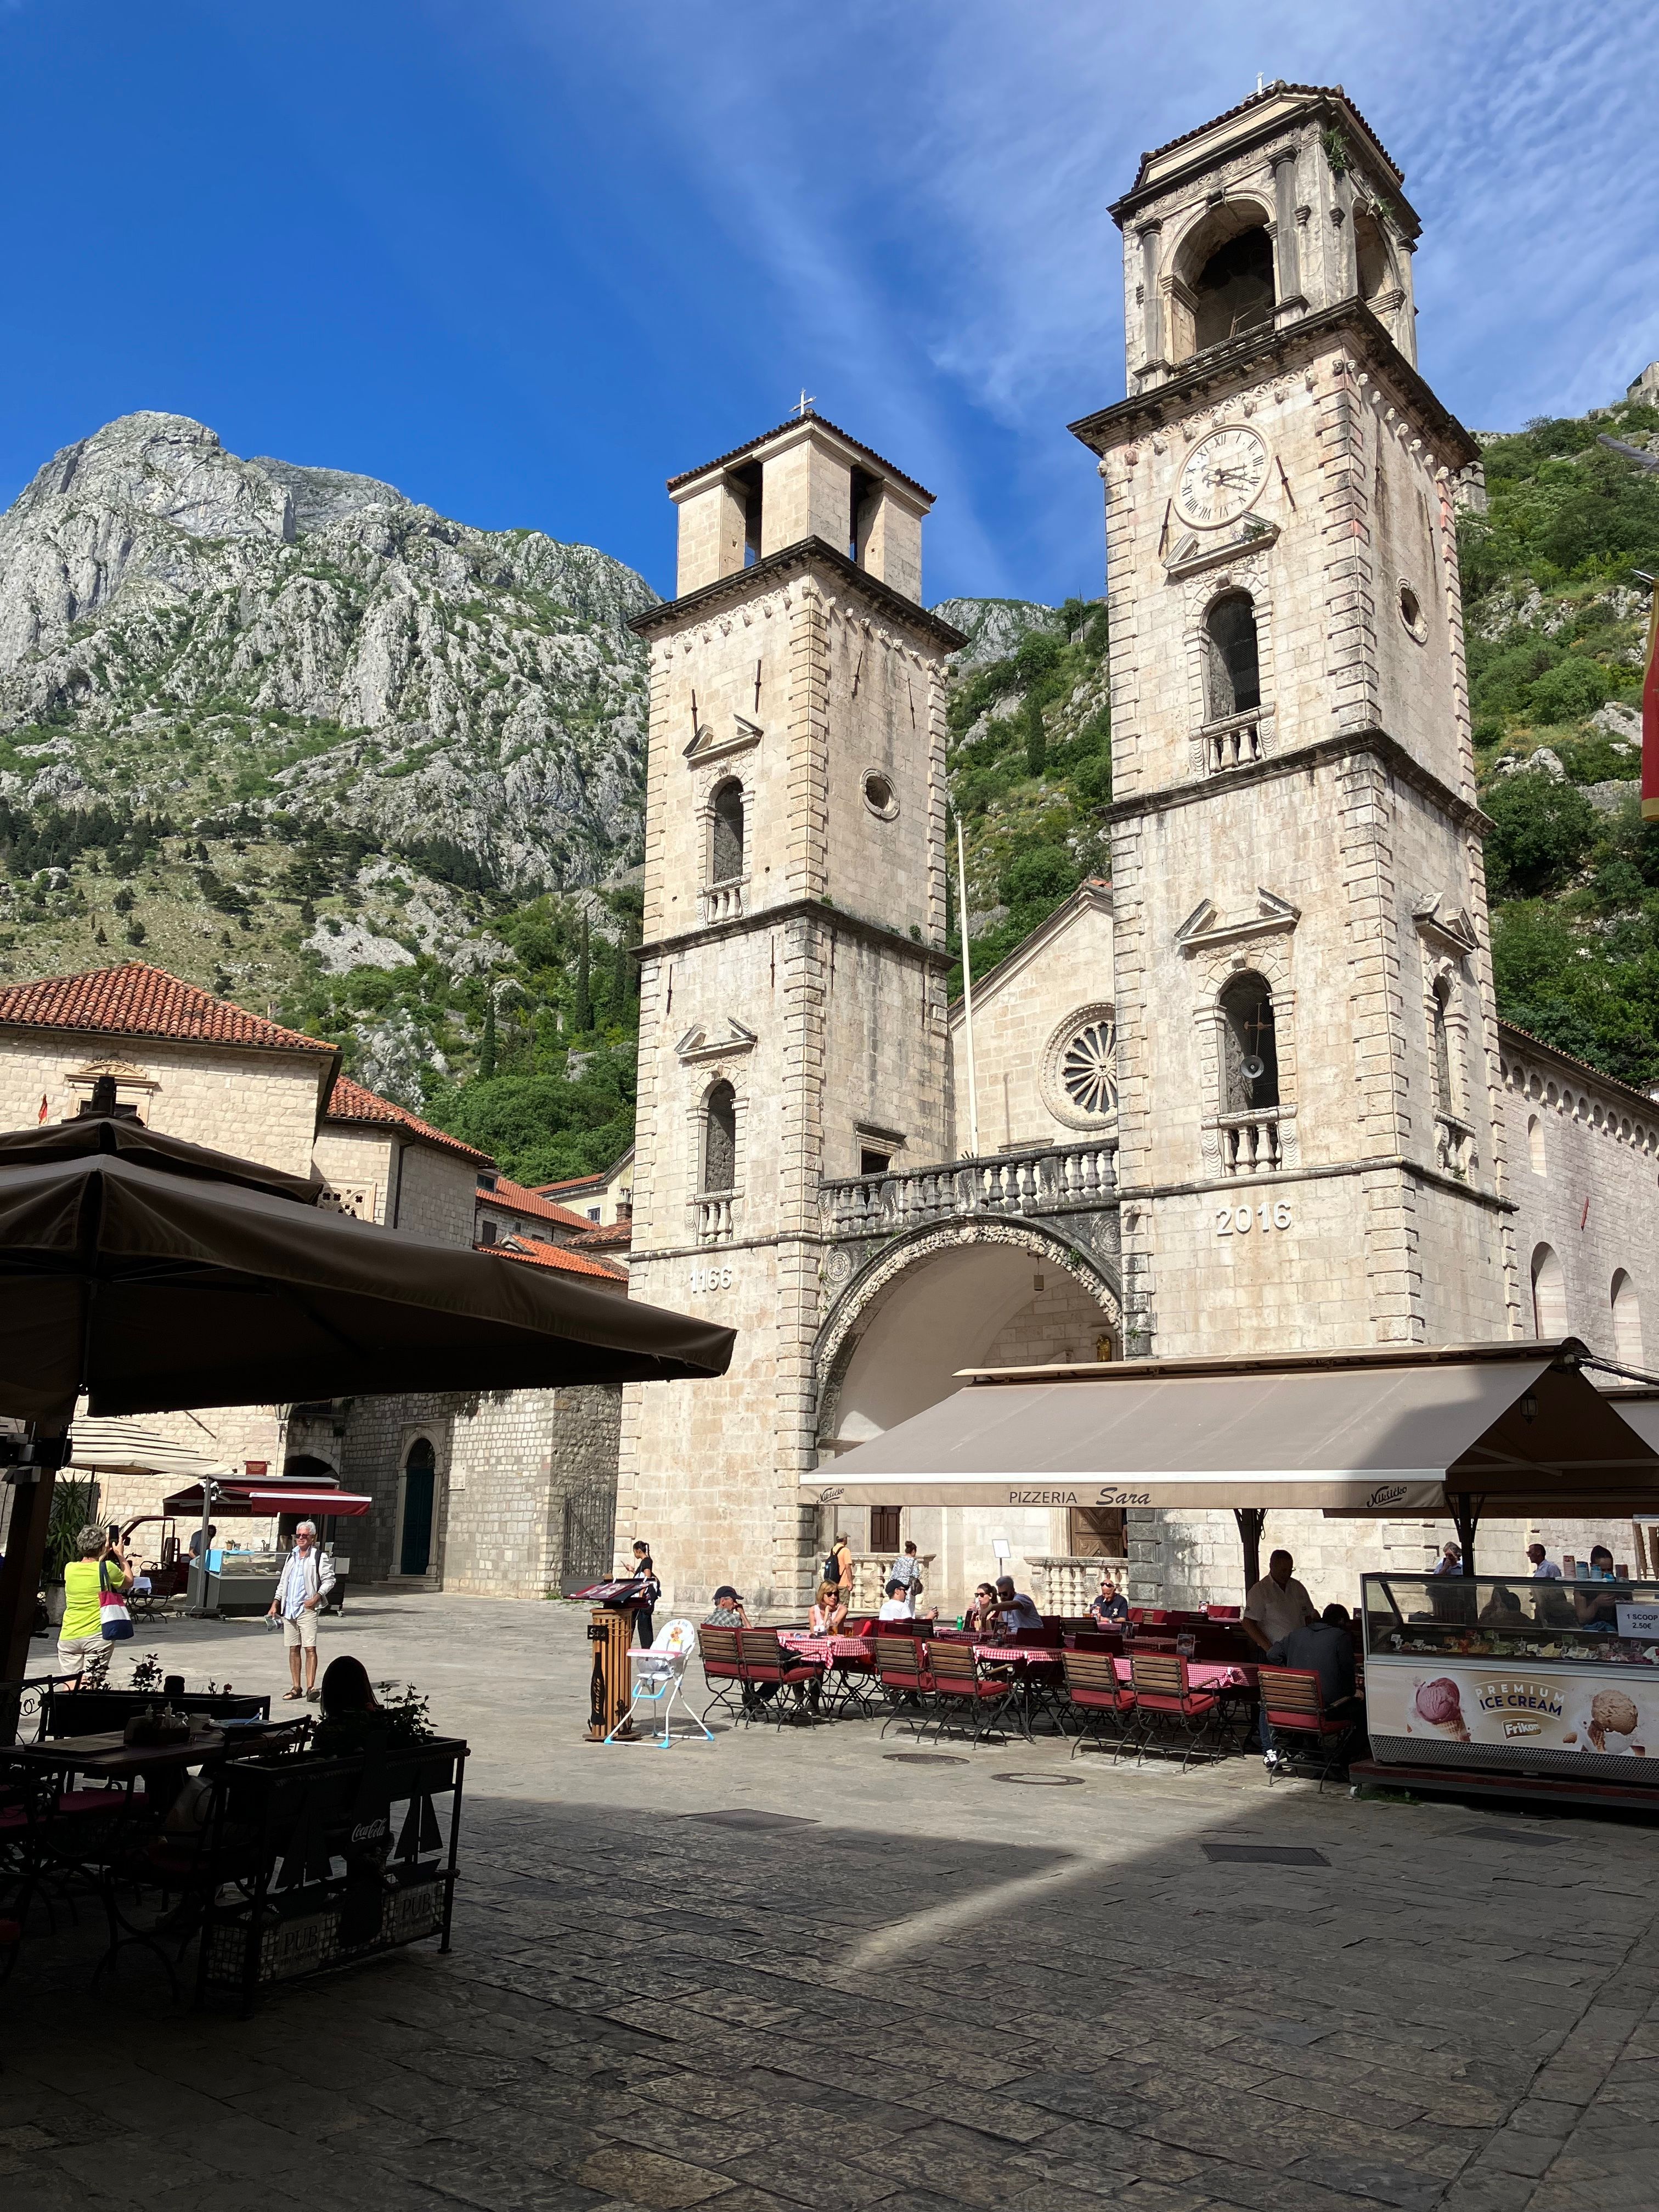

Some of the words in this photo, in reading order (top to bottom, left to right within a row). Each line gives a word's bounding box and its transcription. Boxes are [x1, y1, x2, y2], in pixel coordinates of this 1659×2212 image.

[1216, 1199, 1292, 1237] 2016
[690, 1265, 733, 1294] 1166
[1009, 1491, 1077, 1504] PIZZERIA
[1095, 1487, 1152, 1505] Sara
[1475, 1684, 1565, 1703] PREMIUM
[1479, 1695, 1504, 1711] ICE
[1508, 1695, 1562, 1716] CREAM
[1505, 1722, 1541, 1735] Frikom
[402, 1893, 431, 1920] PUB
[283, 1925, 318, 1956] PUB
